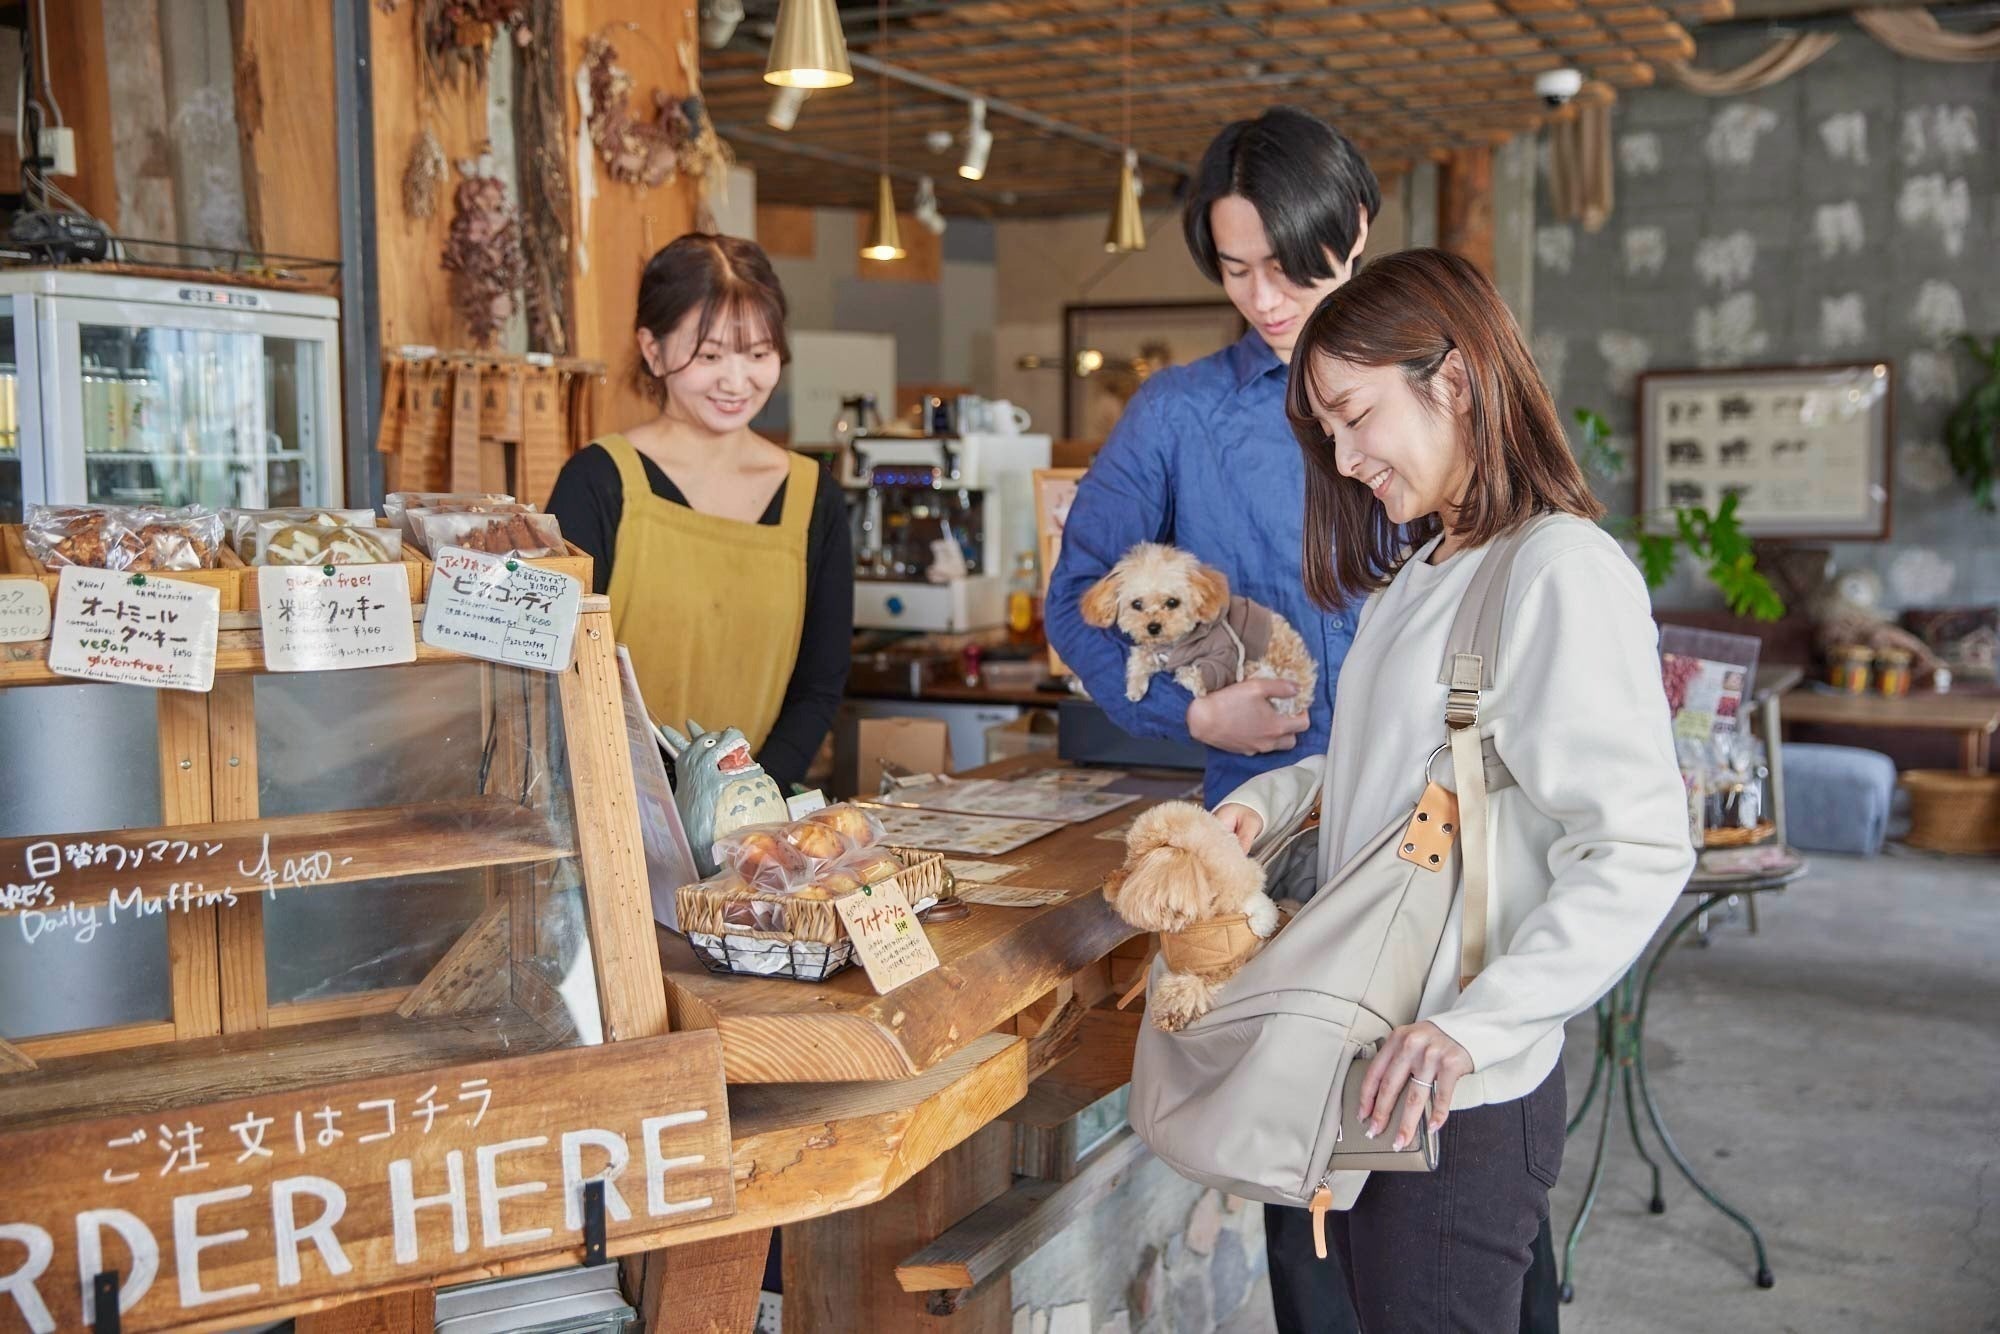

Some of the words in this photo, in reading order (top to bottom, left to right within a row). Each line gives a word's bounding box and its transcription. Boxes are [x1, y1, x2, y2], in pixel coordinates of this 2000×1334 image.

[337, 573, 372, 588] free!
[81, 596, 179, 624] オートミール
[279, 595, 385, 624] 米粉クッキー
[525, 613, 552, 627] ¥400
[79, 637, 129, 653] vegan
[120, 625, 188, 649] クッキー
[26, 841, 223, 880] 日替わりマフィン
[20, 901, 103, 943] Daily
[109, 882, 239, 925] Muffins
[853, 904, 907, 937] フィナンシェ
[104, 1078, 494, 1184] ご注文はコチラ
[388, 1109, 714, 1266] HERE
